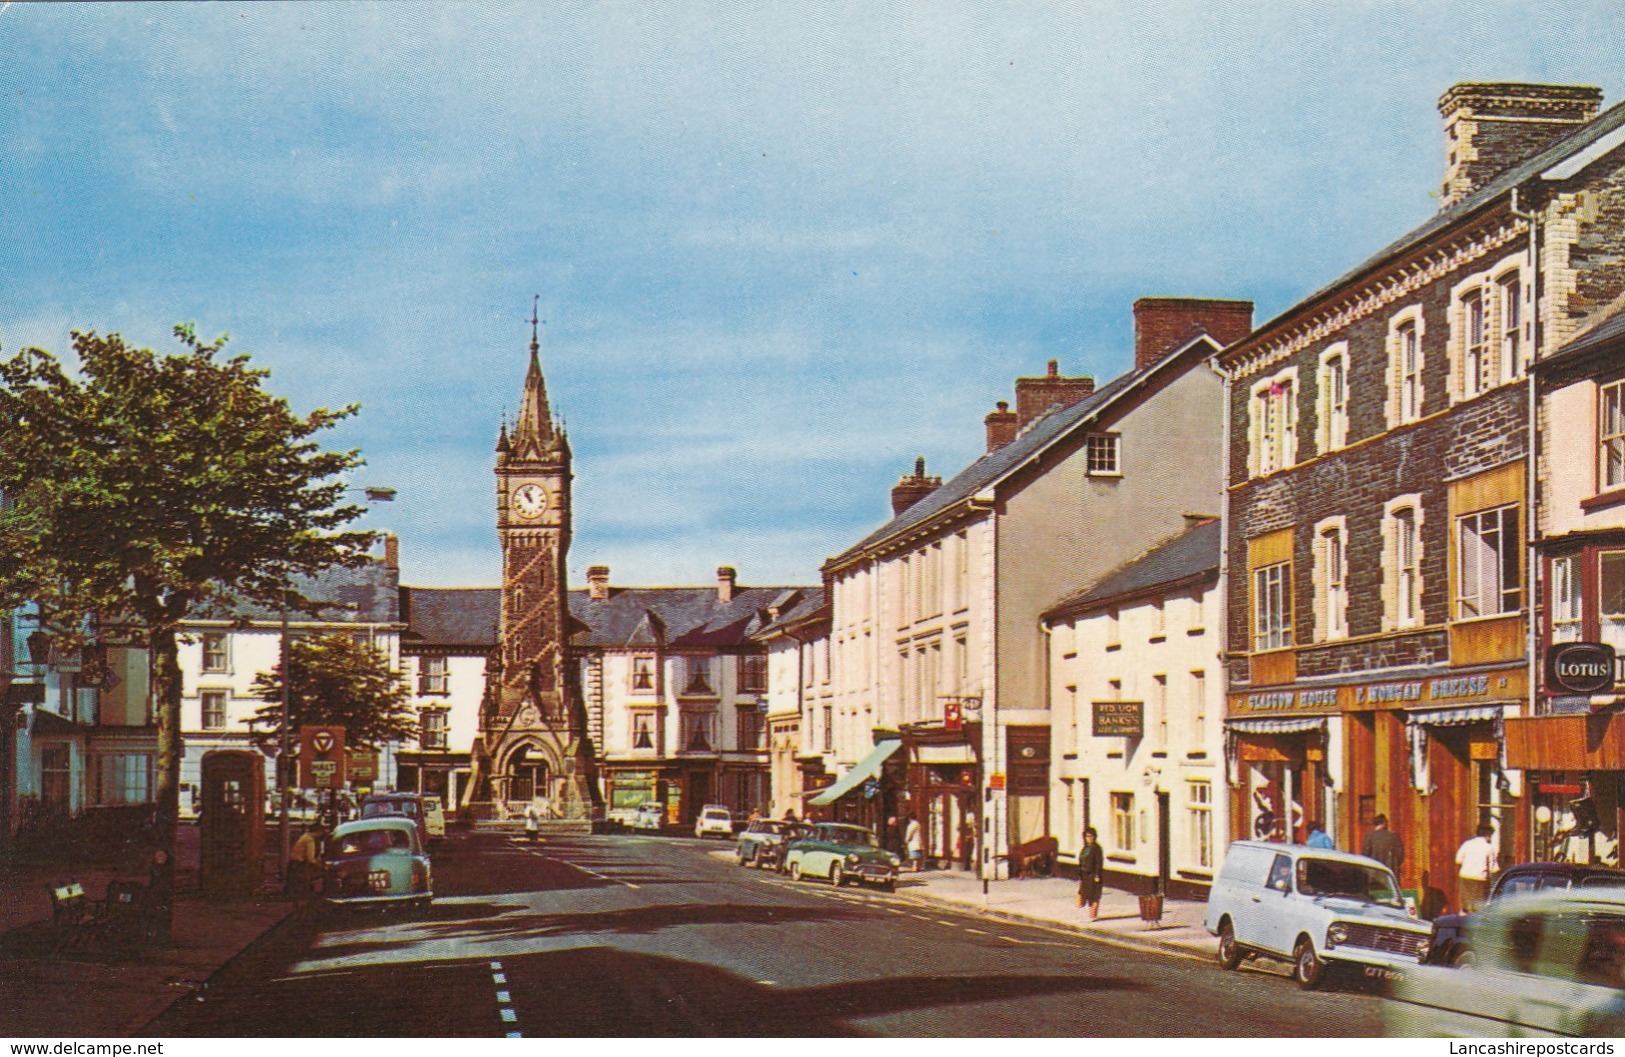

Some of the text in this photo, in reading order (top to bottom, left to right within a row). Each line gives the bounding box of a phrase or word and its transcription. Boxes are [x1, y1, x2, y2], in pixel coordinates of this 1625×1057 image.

[1560, 663, 1607, 677] LOTUS
[1300, 689, 1337, 708] HOUSE
[1368, 681, 1422, 703] MORGAN
[1430, 676, 1489, 700] BREESE
